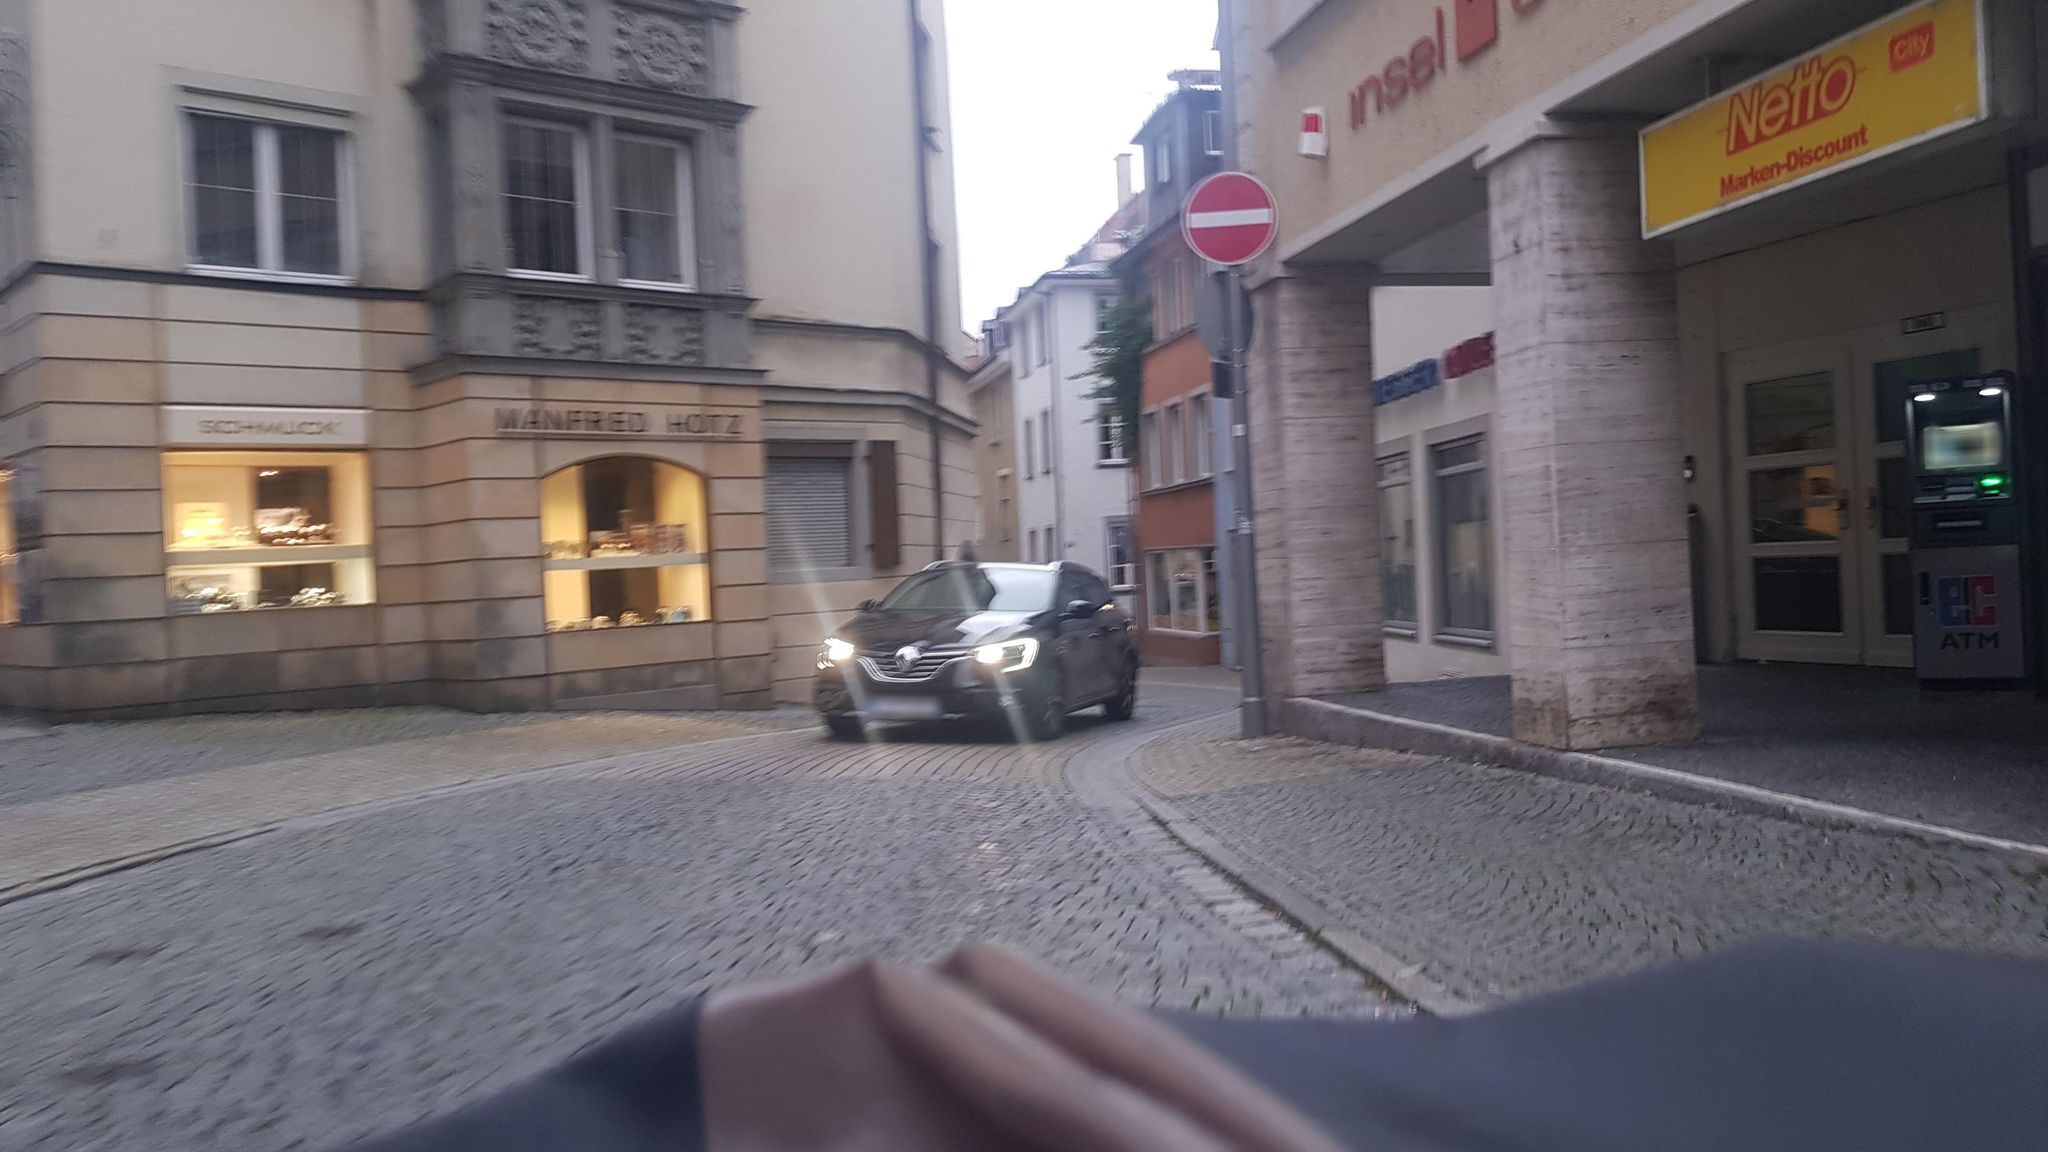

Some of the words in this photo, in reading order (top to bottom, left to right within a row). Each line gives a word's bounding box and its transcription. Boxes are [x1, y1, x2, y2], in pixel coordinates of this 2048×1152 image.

[1892, 29, 1932, 63] City
[1349, 6, 1447, 130] insel
[1725, 53, 1857, 158] Netto
[1719, 123, 1869, 199] Marken-Discount
[197, 418, 343, 436] SCHMUCK
[494, 407, 648, 433] MANFRED
[666, 412, 745, 435] HOTZ
[1939, 631, 2000, 651] ATM
